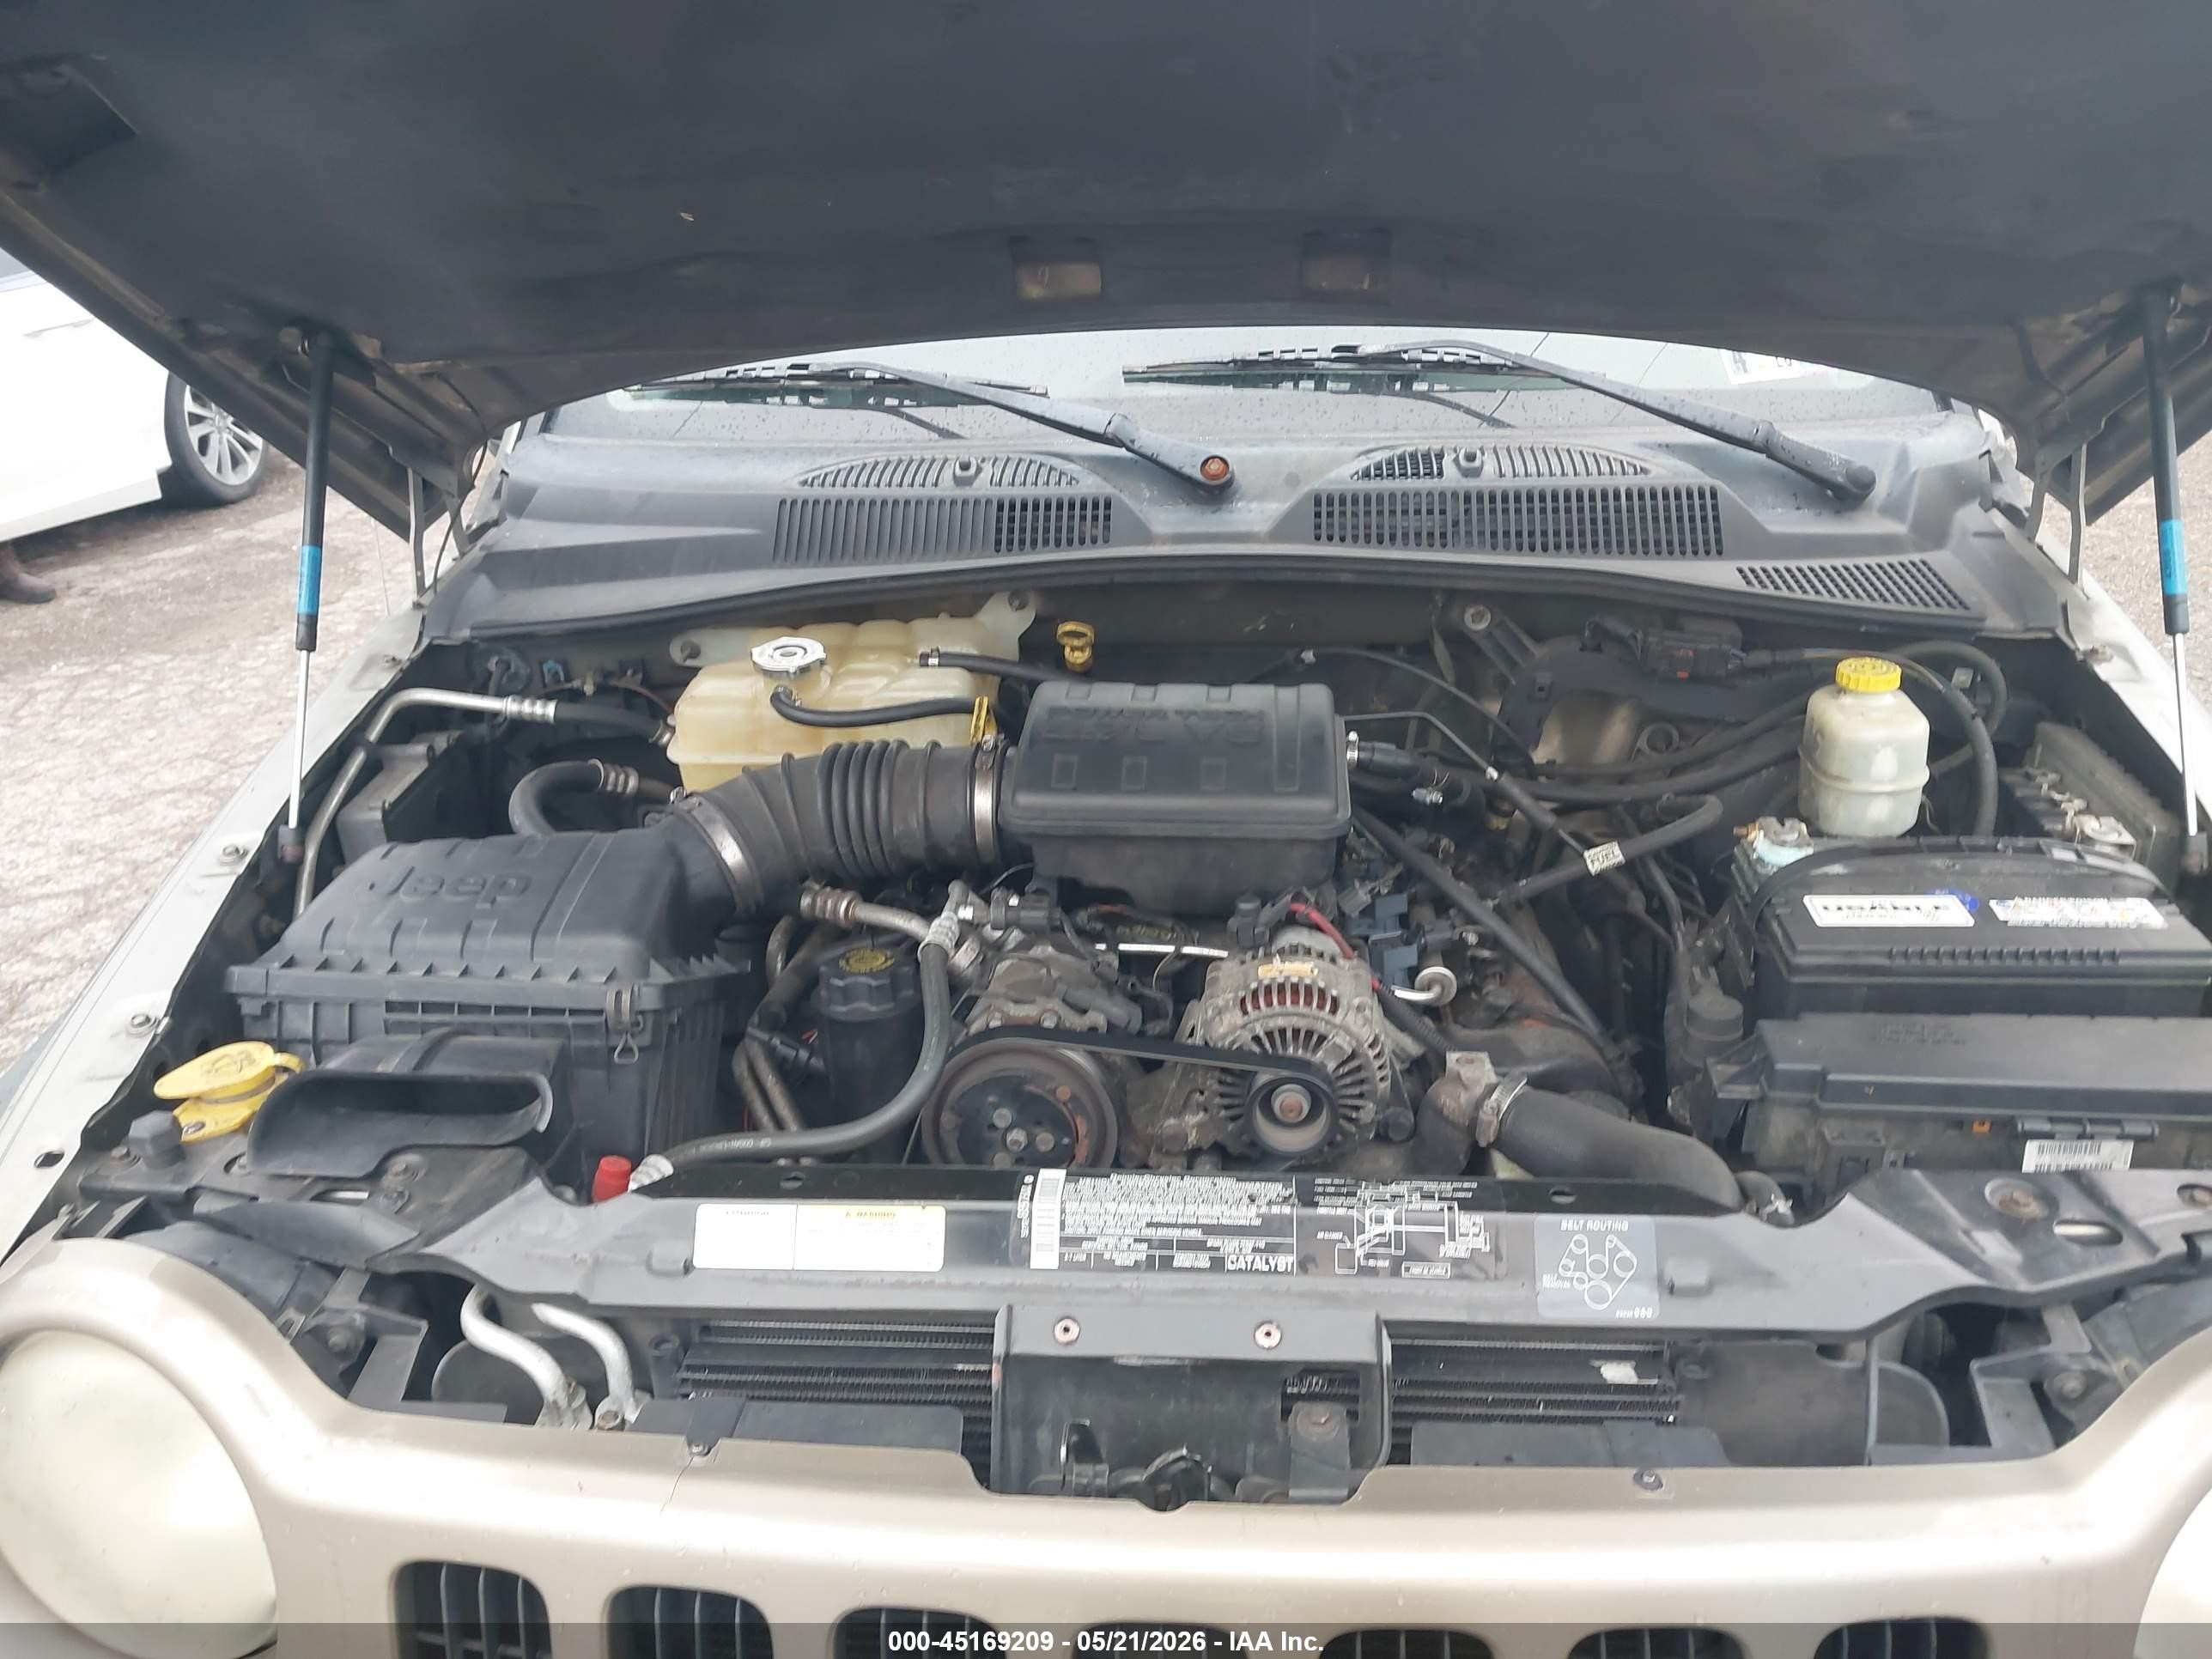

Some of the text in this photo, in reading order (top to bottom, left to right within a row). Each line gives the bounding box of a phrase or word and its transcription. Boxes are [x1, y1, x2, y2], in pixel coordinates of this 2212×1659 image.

[367, 865, 534, 909] Jeep
[1560, 1219, 1629, 1232] BELT ROUTING
[1226, 1255, 1294, 1272] CATALYST
